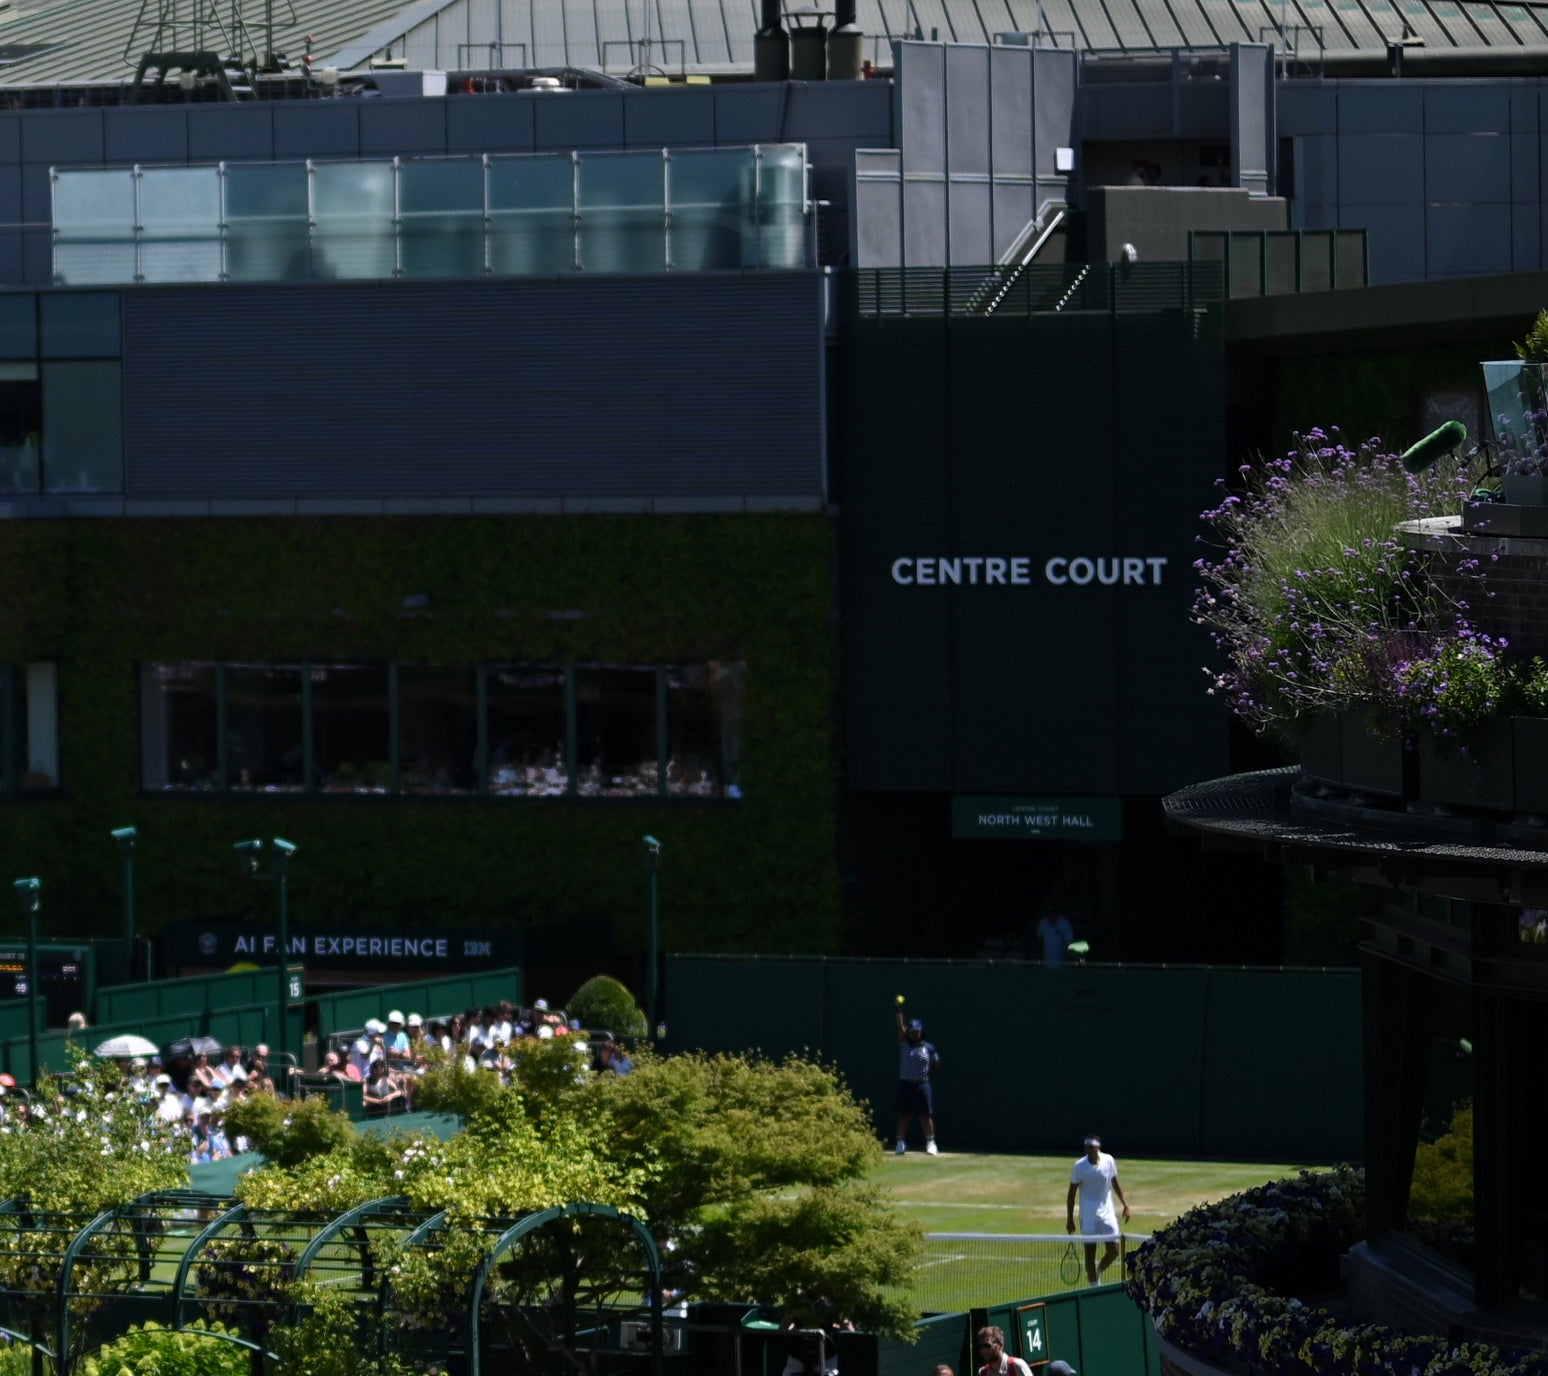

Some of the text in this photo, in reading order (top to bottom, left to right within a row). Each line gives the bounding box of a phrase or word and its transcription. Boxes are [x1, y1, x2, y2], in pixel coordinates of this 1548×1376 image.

[890, 556, 1169, 586] CENTRE COURT
[978, 814, 1093, 828] NORTH WEST HALL
[234, 936, 256, 954] AI
[314, 936, 448, 958] EXPERIENCE
[463, 941, 492, 957] IBM
[288, 982, 300, 998] 15
[1026, 1327, 1042, 1353] 14
